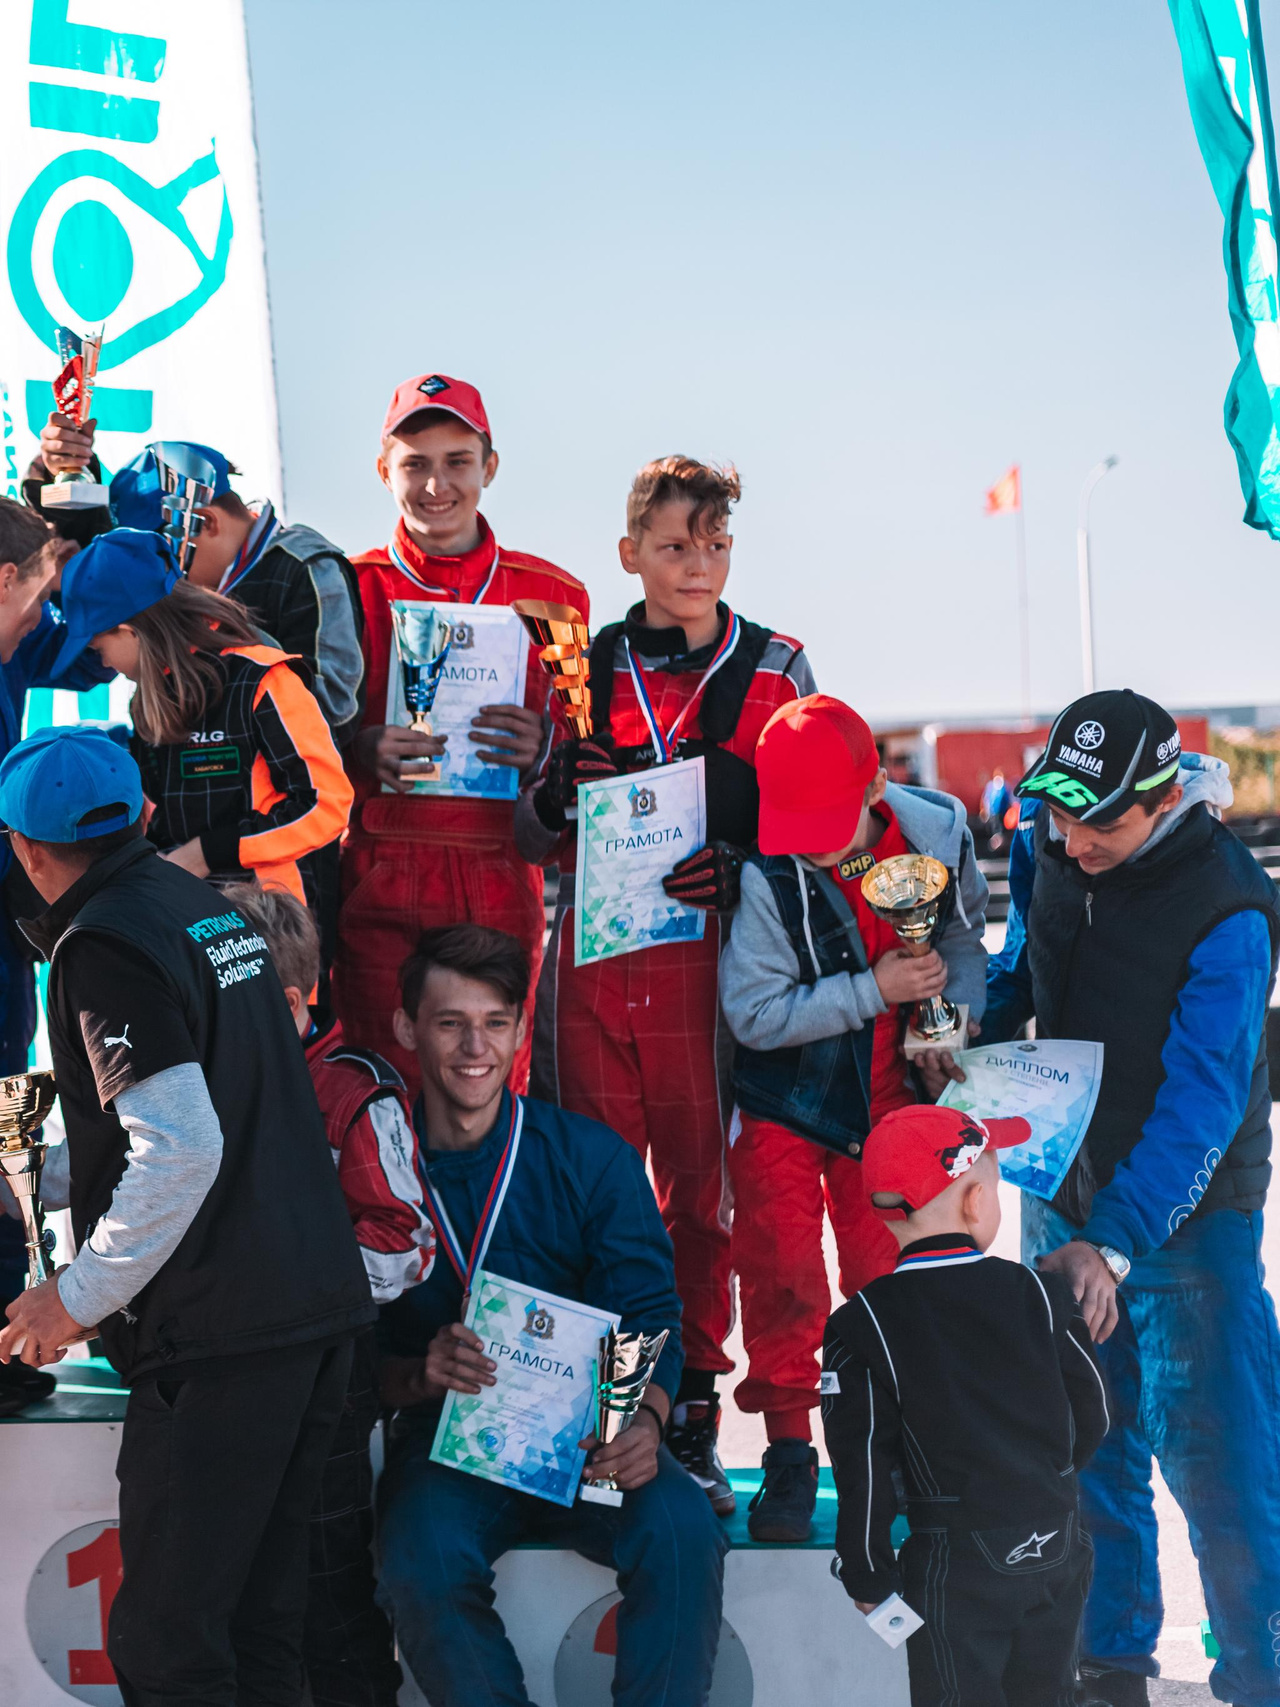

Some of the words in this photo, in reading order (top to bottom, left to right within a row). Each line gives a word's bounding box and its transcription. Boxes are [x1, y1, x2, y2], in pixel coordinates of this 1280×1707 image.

[442, 665, 498, 682] АМОТА
[190, 730, 225, 743] RLG
[1059, 744, 1104, 774] YAMAHA
[1020, 771, 1099, 808] 46
[605, 826, 683, 854] ГРАМОТА
[841, 854, 872, 877] OMP
[186, 911, 246, 943] PETRONAS
[986, 1056, 1069, 1085] ДИПЛОМ
[489, 1341, 574, 1380] ГРАМОТА
